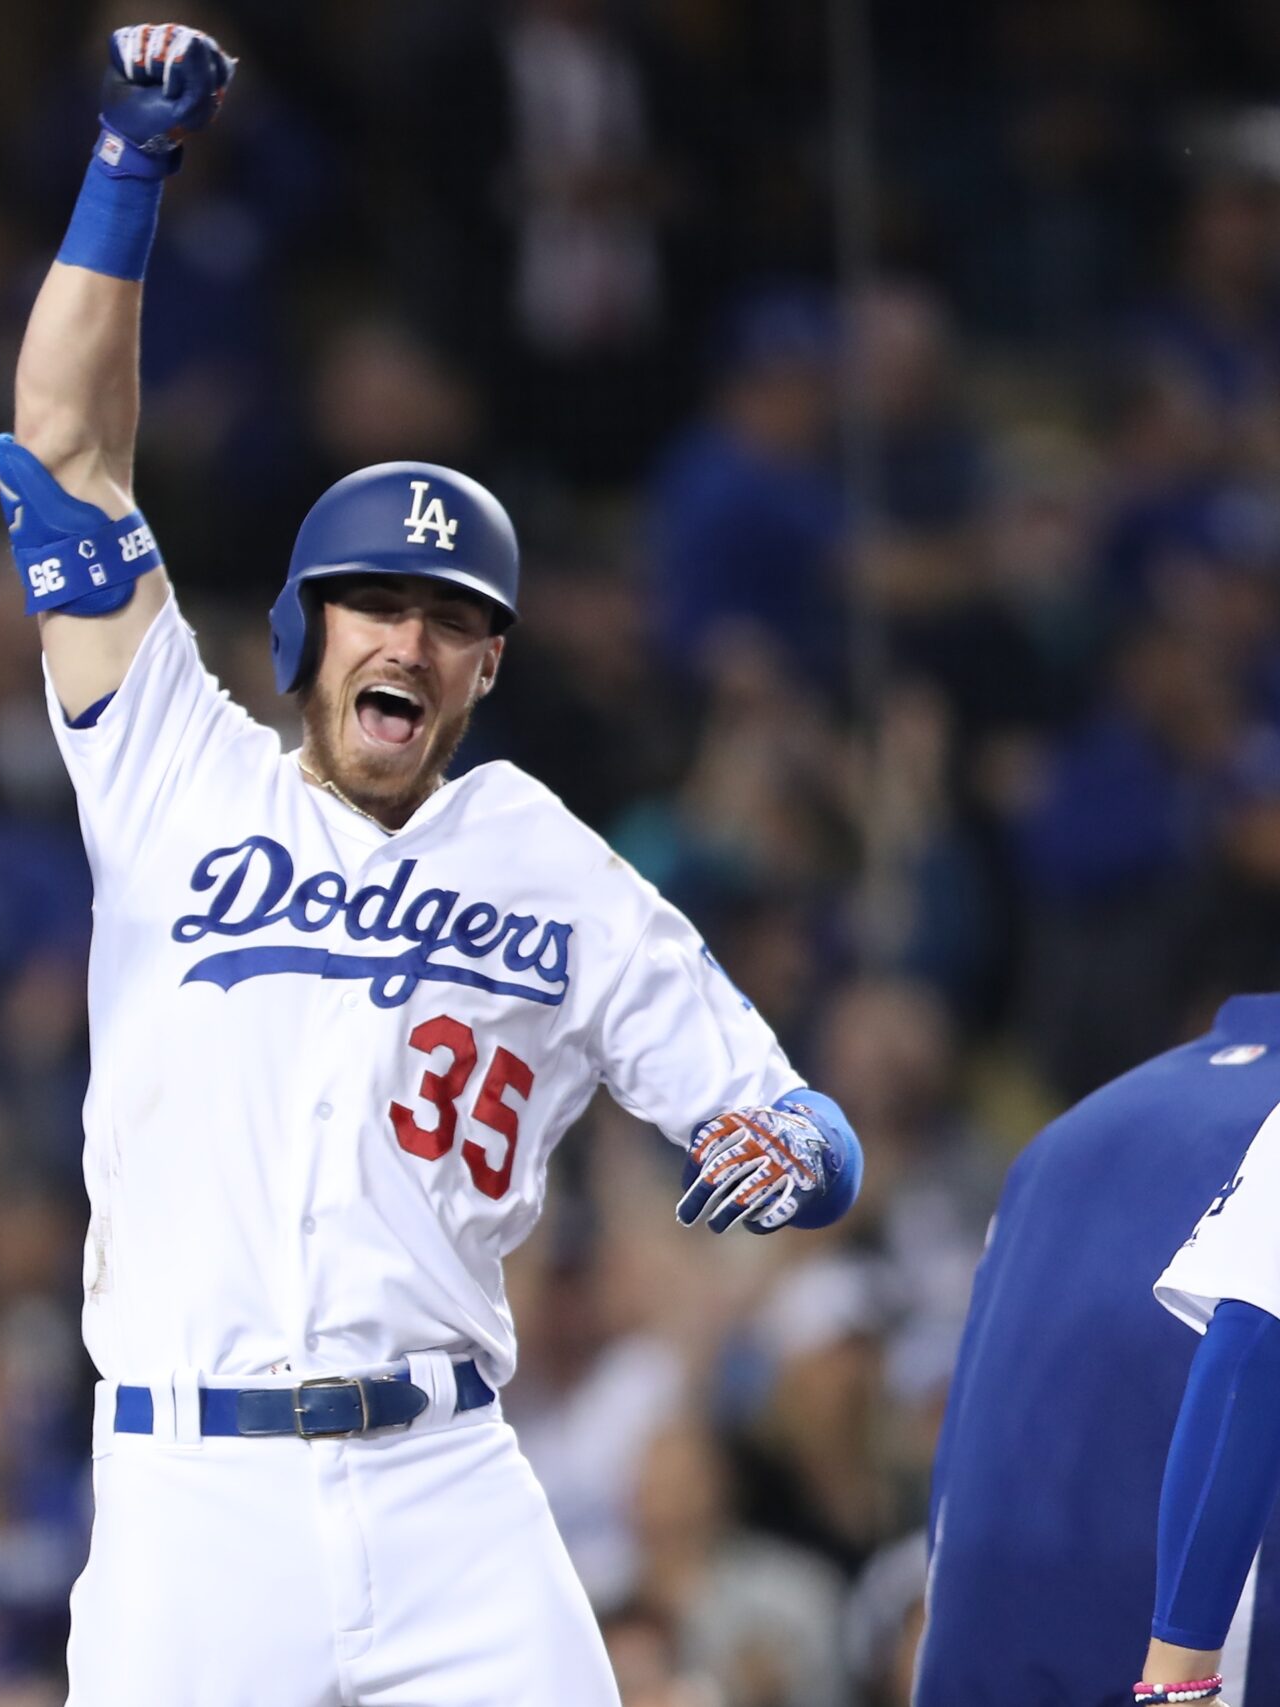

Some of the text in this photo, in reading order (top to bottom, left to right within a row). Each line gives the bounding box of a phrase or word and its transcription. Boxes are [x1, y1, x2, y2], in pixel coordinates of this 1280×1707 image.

[404, 481, 458, 551] LA
[28, 557, 66, 598] 35
[171, 835, 573, 1008] Dodgers
[389, 1014, 535, 1201] 35
